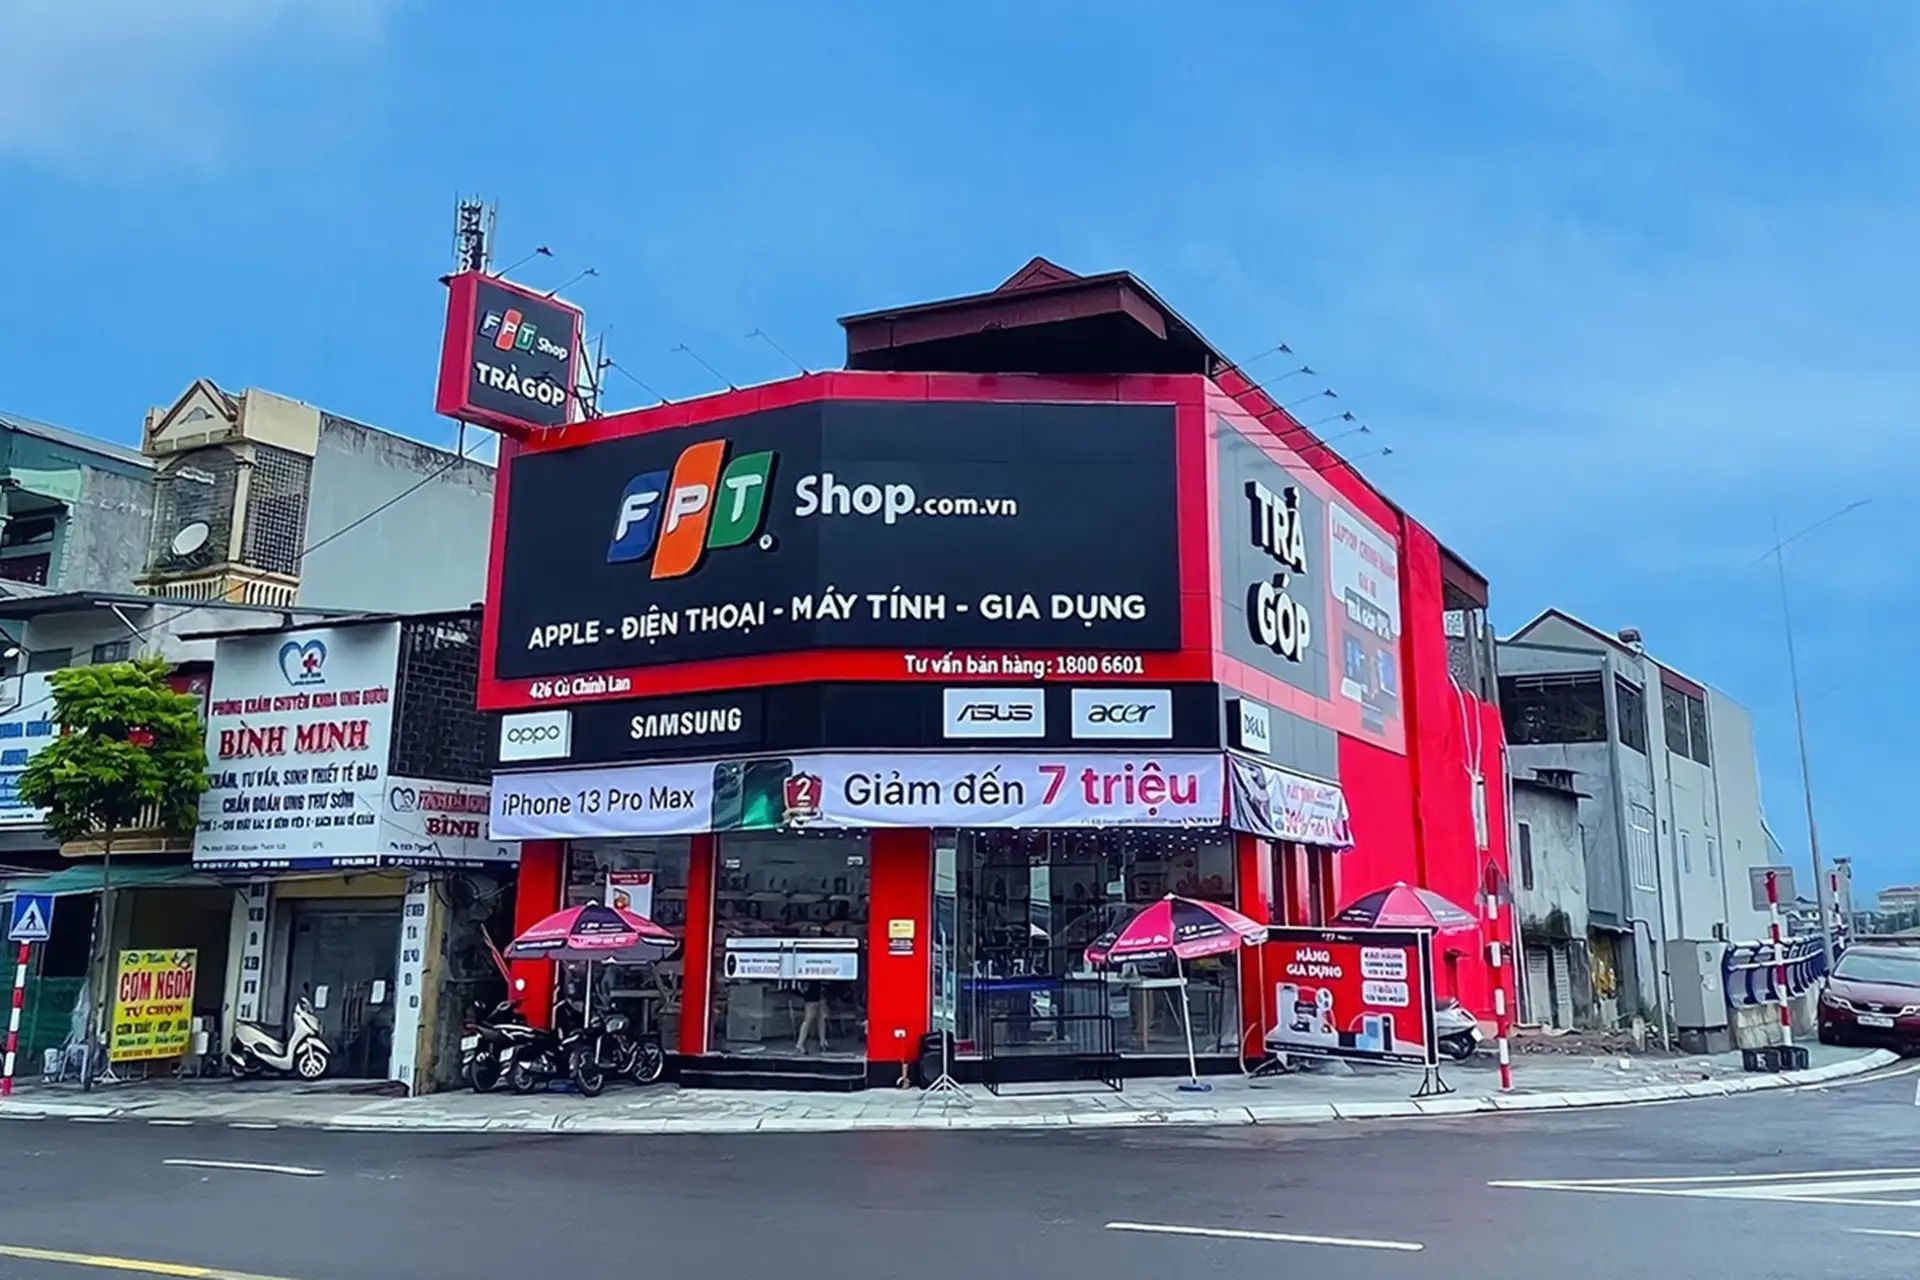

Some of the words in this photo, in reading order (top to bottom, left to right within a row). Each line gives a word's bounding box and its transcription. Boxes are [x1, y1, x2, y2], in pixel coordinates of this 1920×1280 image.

[537, 337, 568, 361] Shop
[795, 473, 1017, 524] Shop.com.vn
[528, 620, 600, 650] APPLE
[621, 604, 678, 646] ĐIỆN
[685, 601, 765, 634] THOẠI
[791, 585, 858, 621] MÁY
[866, 585, 946, 620] TÍNH
[979, 594, 1041, 620] GIA
[1051, 594, 1147, 627] DỤNG
[1253, 573, 1310, 663] GÓP
[904, 653, 932, 674] Tư
[933, 651, 964, 674] vấn
[966, 654, 999, 674] bán
[1002, 654, 1053, 680] hàng:
[1056, 655, 1098, 675] 1800
[1101, 655, 1144, 675] 6601
[528, 679, 553, 700] 426
[554, 676, 571, 697] Cù
[572, 674, 607, 696] Chính
[608, 674, 632, 694] Lan
[630, 707, 742, 740] SAMSUNG
[956, 703, 1033, 723] ASUS
[1088, 704, 1156, 725] acer
[1243, 713, 1267, 739] DELL
[218, 720, 289, 760] BÌNH
[294, 719, 371, 753] MINH
[794, 775, 813, 801] 2
[843, 771, 940, 806] Giảm
[953, 764, 1024, 806] đến
[1037, 765, 1068, 806] 7
[1081, 762, 1198, 816] triệu
[501, 791, 572, 817] iPhone
[578, 790, 600, 814] 13
[608, 788, 643, 813] Pro
[649, 786, 695, 810] Max
[426, 814, 480, 838] BÌNH
[1295, 947, 1330, 963] HÀNG
[1286, 964, 1306, 976] GIA
[1308, 965, 1342, 979] DỤNG
[120, 968, 152, 1002] CƠM
[155, 968, 193, 1000] NGON
[124, 1005, 143, 1018] TỰ
[146, 1004, 184, 1017] CHỌN
